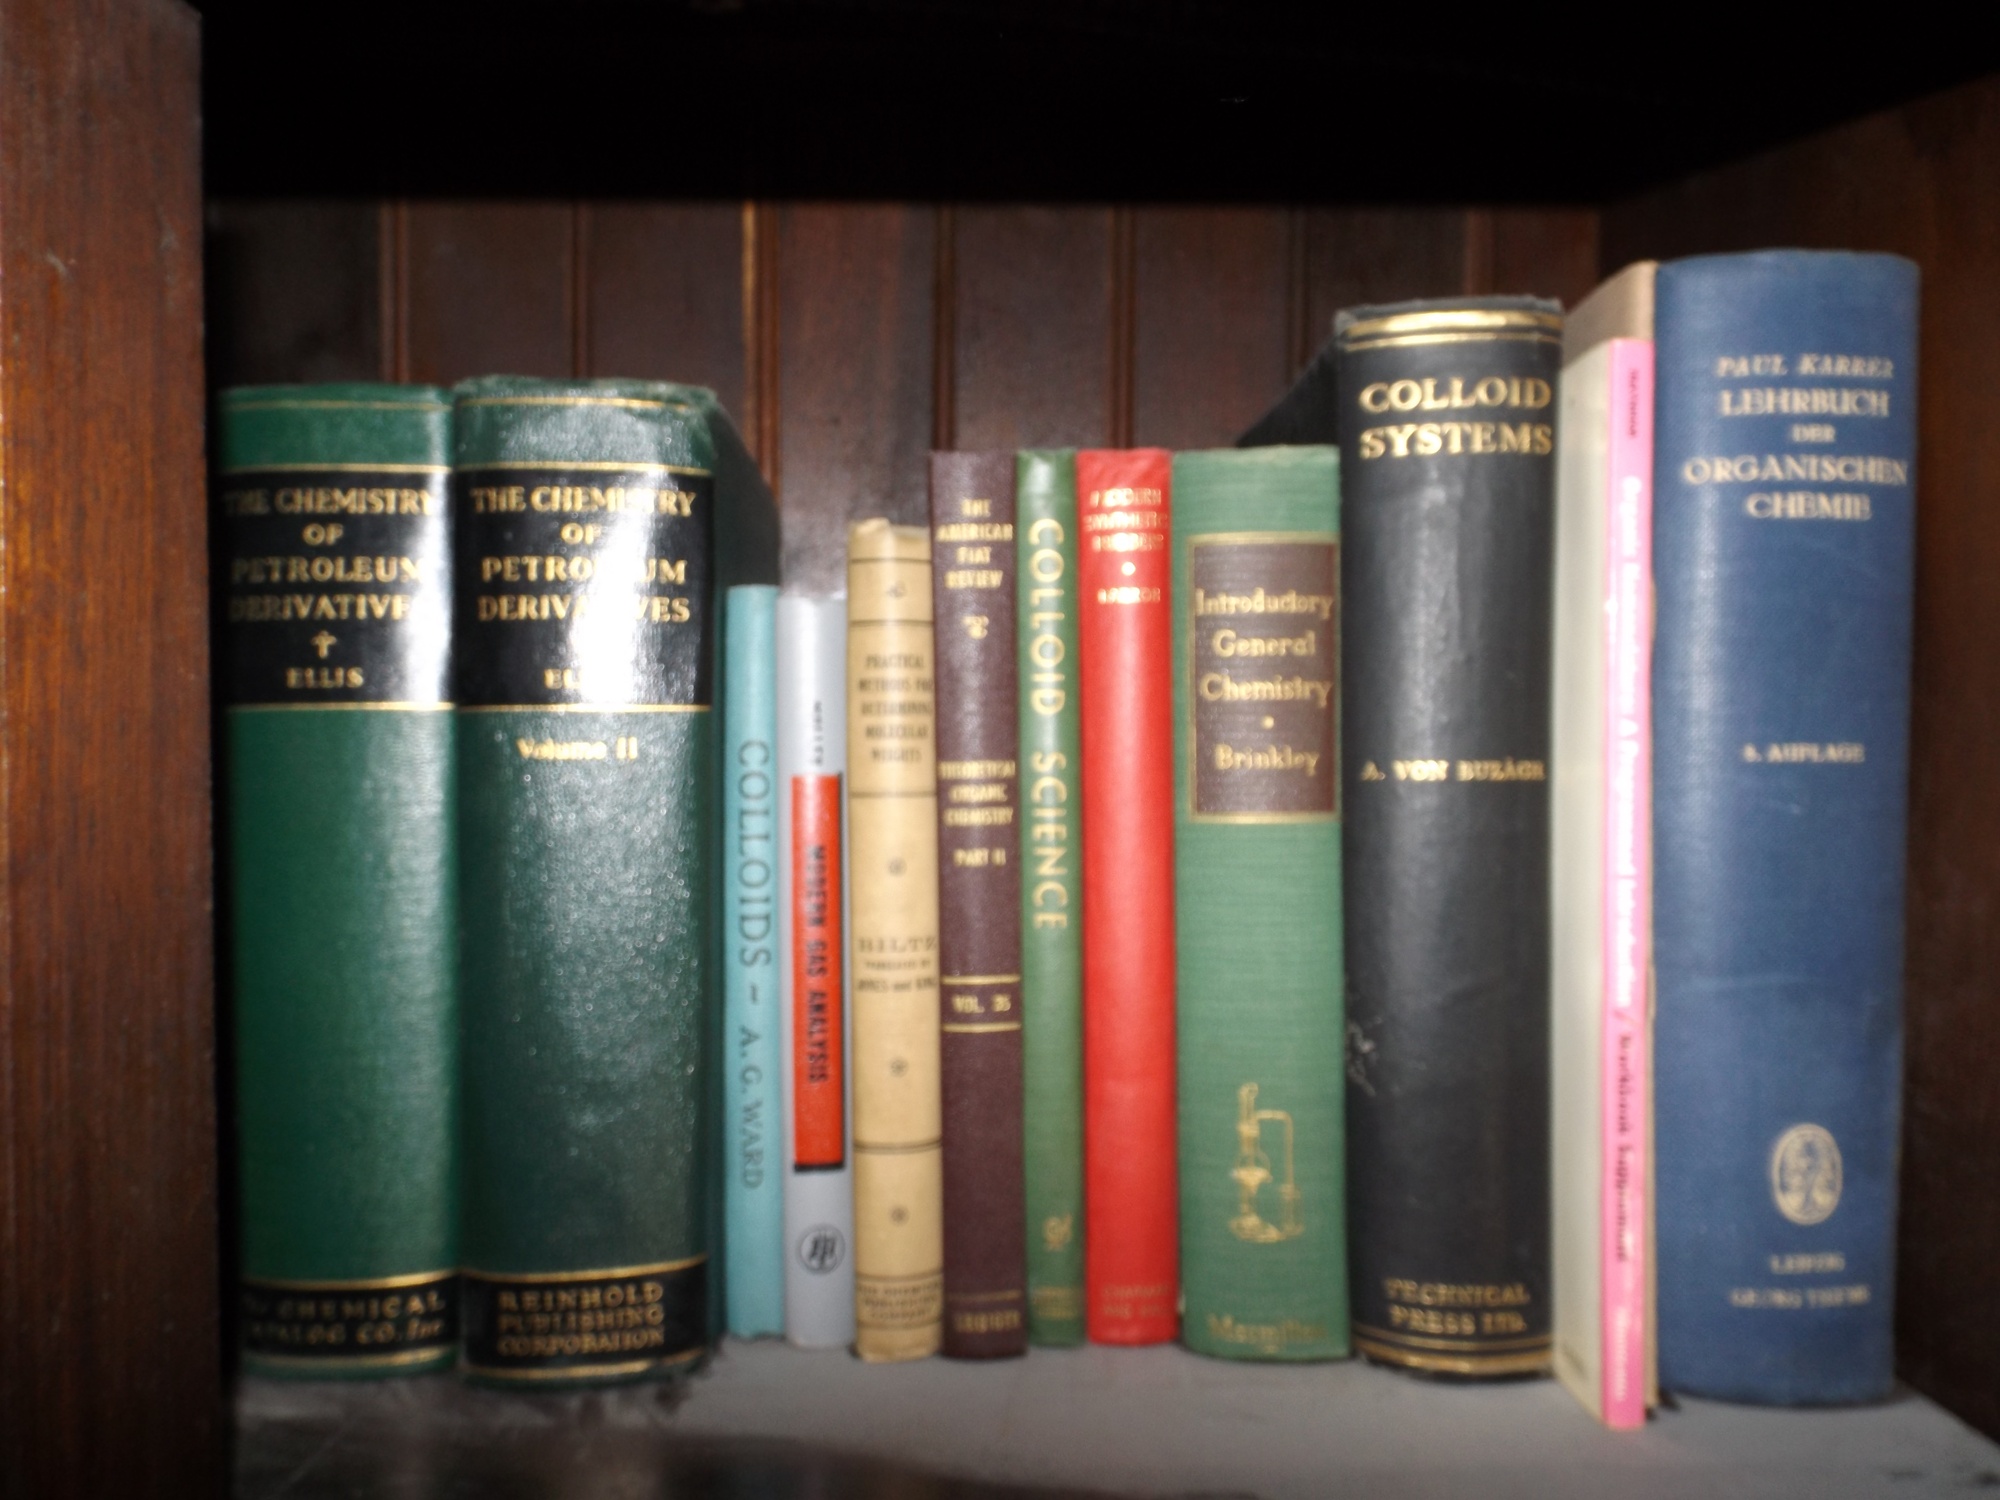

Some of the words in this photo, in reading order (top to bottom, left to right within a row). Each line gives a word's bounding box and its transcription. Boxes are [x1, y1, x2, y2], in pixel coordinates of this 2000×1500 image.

[1717, 354, 1788, 377] PAUL
[1797, 353, 1894, 378] KARRER
[1359, 376, 1551, 413] COLLOID
[1720, 387, 1889, 416] LEHRBUCH
[1360, 422, 1552, 459] SYSTEMS
[1791, 423, 1836, 443] DER
[1683, 454, 1907, 486] ORGANISCHEN
[225, 488, 269, 516] THE
[274, 487, 433, 516] CHEMISTRY
[470, 486, 526, 514] THE
[1745, 491, 1872, 520] CHEMIE
[303, 523, 344, 545] OF
[561, 523, 601, 545] OF
[936, 523, 1013, 541] AMERICAN
[1028, 518, 1067, 716] COLLOID
[1194, 587, 1334, 620] Introductory
[1212, 629, 1316, 657] General
[286, 667, 364, 688] ELLIS
[1201, 673, 1334, 708] Chemistry
[516, 738, 607, 761] Volume
[1214, 743, 1319, 776] Brinkley
[1767, 742, 1865, 762] AUFLAGE
[1360, 760, 1386, 781] A.
[1392, 760, 1449, 781] VON
[737, 738, 773, 968] COLLOIDS
[1031, 751, 1068, 929] SCIENCE
[953, 848, 989, 867] PART
[805, 846, 827, 927] MODERN
[805, 939, 828, 977] GAS
[807, 990, 829, 1084] ANALYSIS
[1617, 1034, 1633, 1135] Workbook
[742, 1100, 765, 1190] WARD
[1615, 1143, 1632, 1262] Supplement
[276, 1290, 445, 1319] CHEMICAL
[498, 1282, 664, 1312] REINHOLD
[1384, 1279, 1531, 1307] TECHNICAL
[498, 1303, 665, 1332] PUBLISHING
[1388, 1304, 1476, 1335] PRESS
[497, 1324, 665, 1356] CORPORATION
